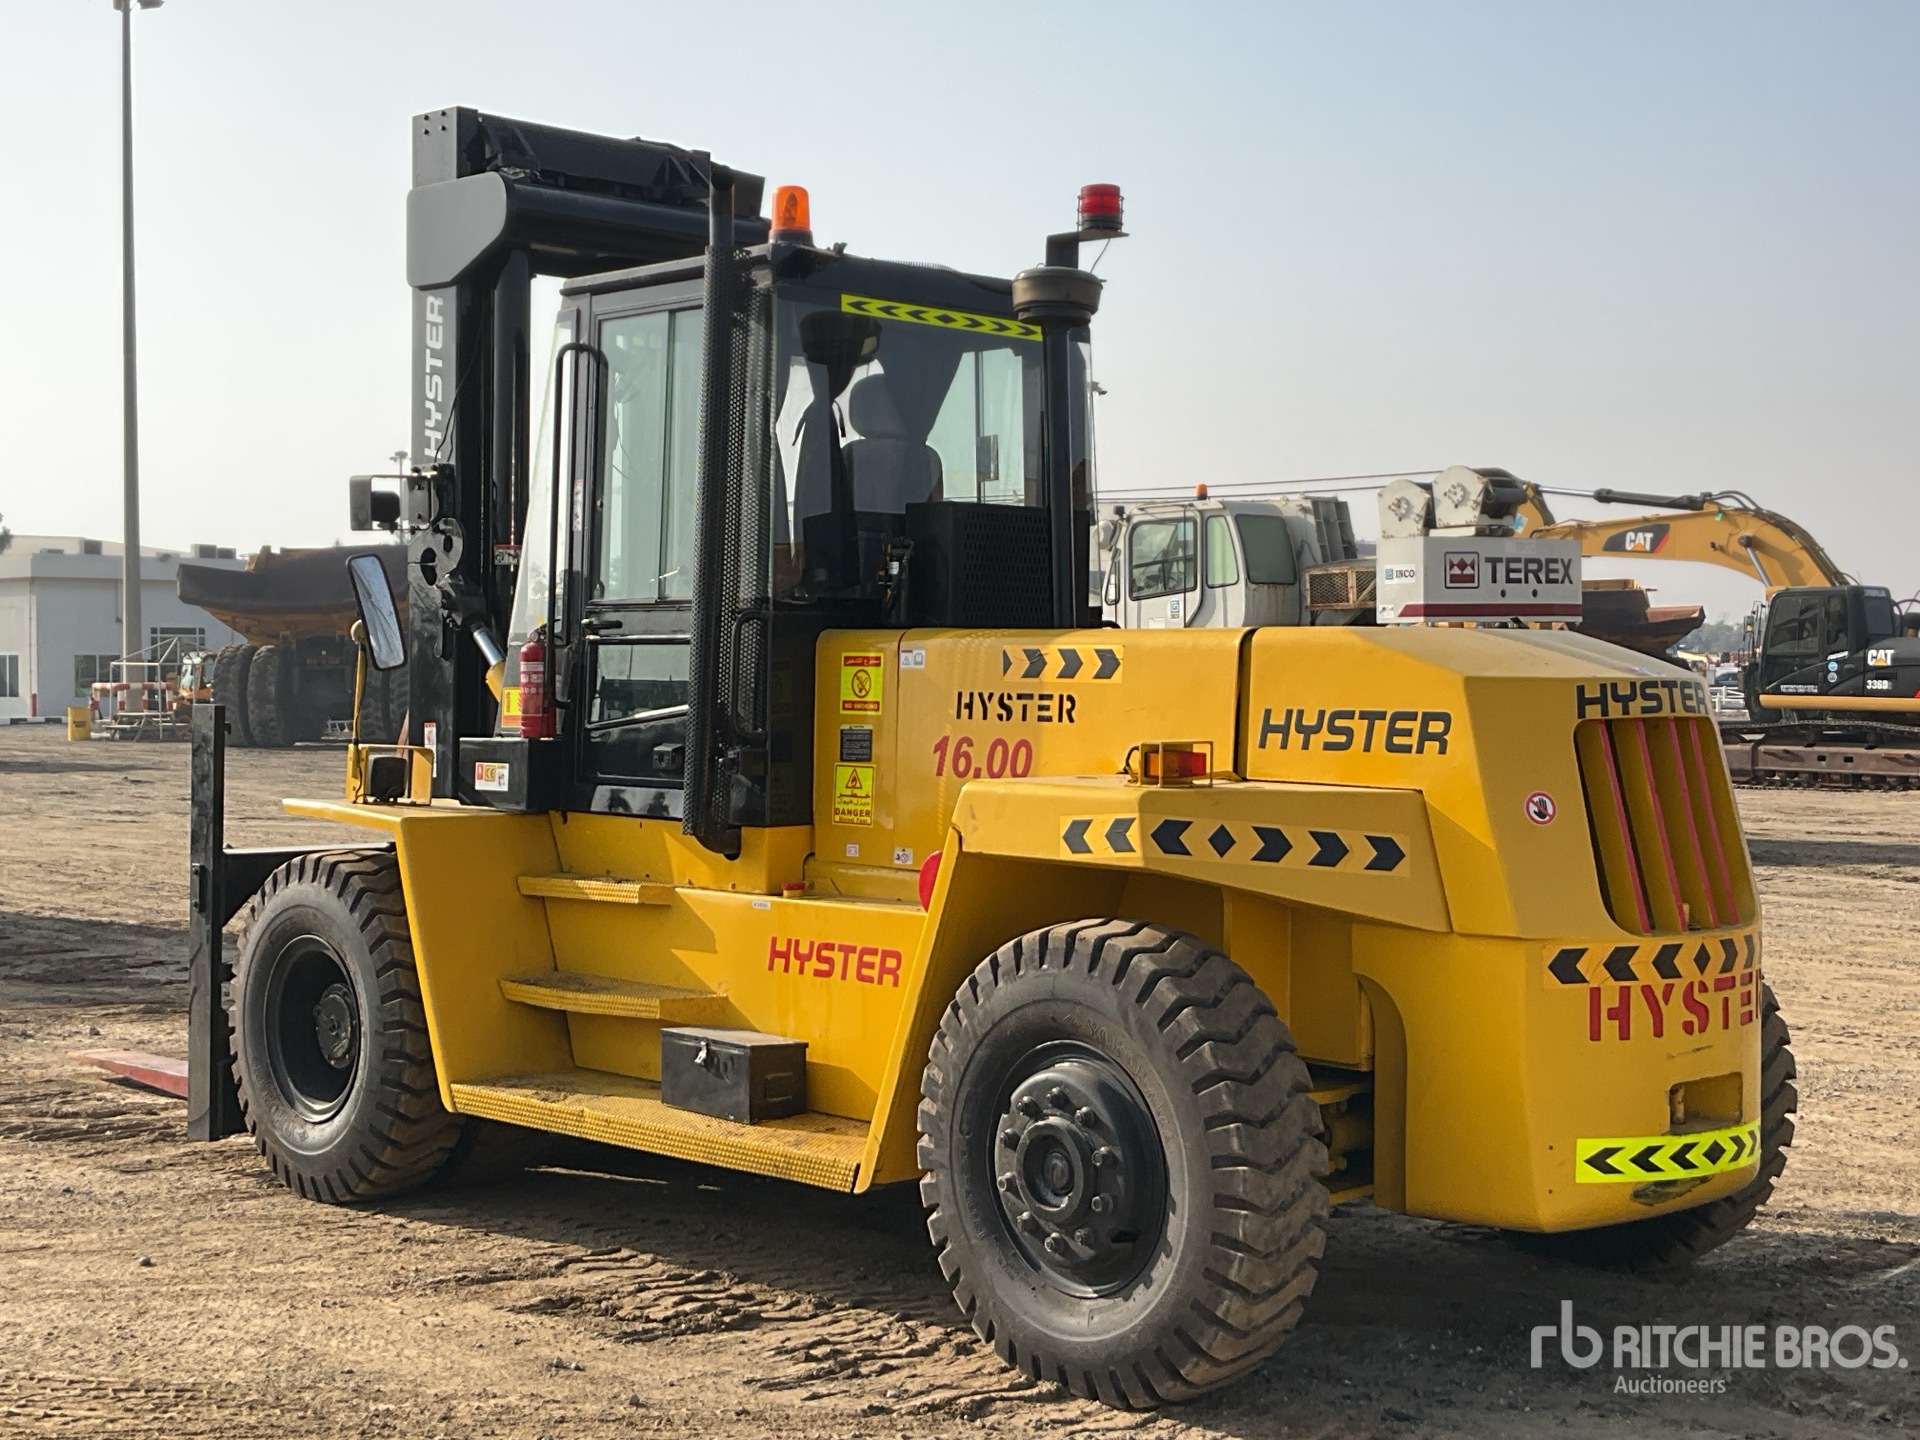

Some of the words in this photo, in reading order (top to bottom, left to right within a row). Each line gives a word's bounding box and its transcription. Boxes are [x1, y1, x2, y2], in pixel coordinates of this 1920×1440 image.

[424, 295, 444, 459] HYSTER
[1625, 531, 1654, 551] CAT
[1395, 569, 1415, 578] INCO
[1485, 557, 1574, 585] TEREX
[1867, 649, 1895, 666] CAT
[956, 691, 1077, 723] HYSTER
[1576, 680, 1709, 719] HYSTER
[1258, 708, 1452, 755] HYSTER
[933, 735, 1033, 778] 16.00
[835, 807, 871, 817] DANGER
[768, 936, 903, 988] HYSTER
